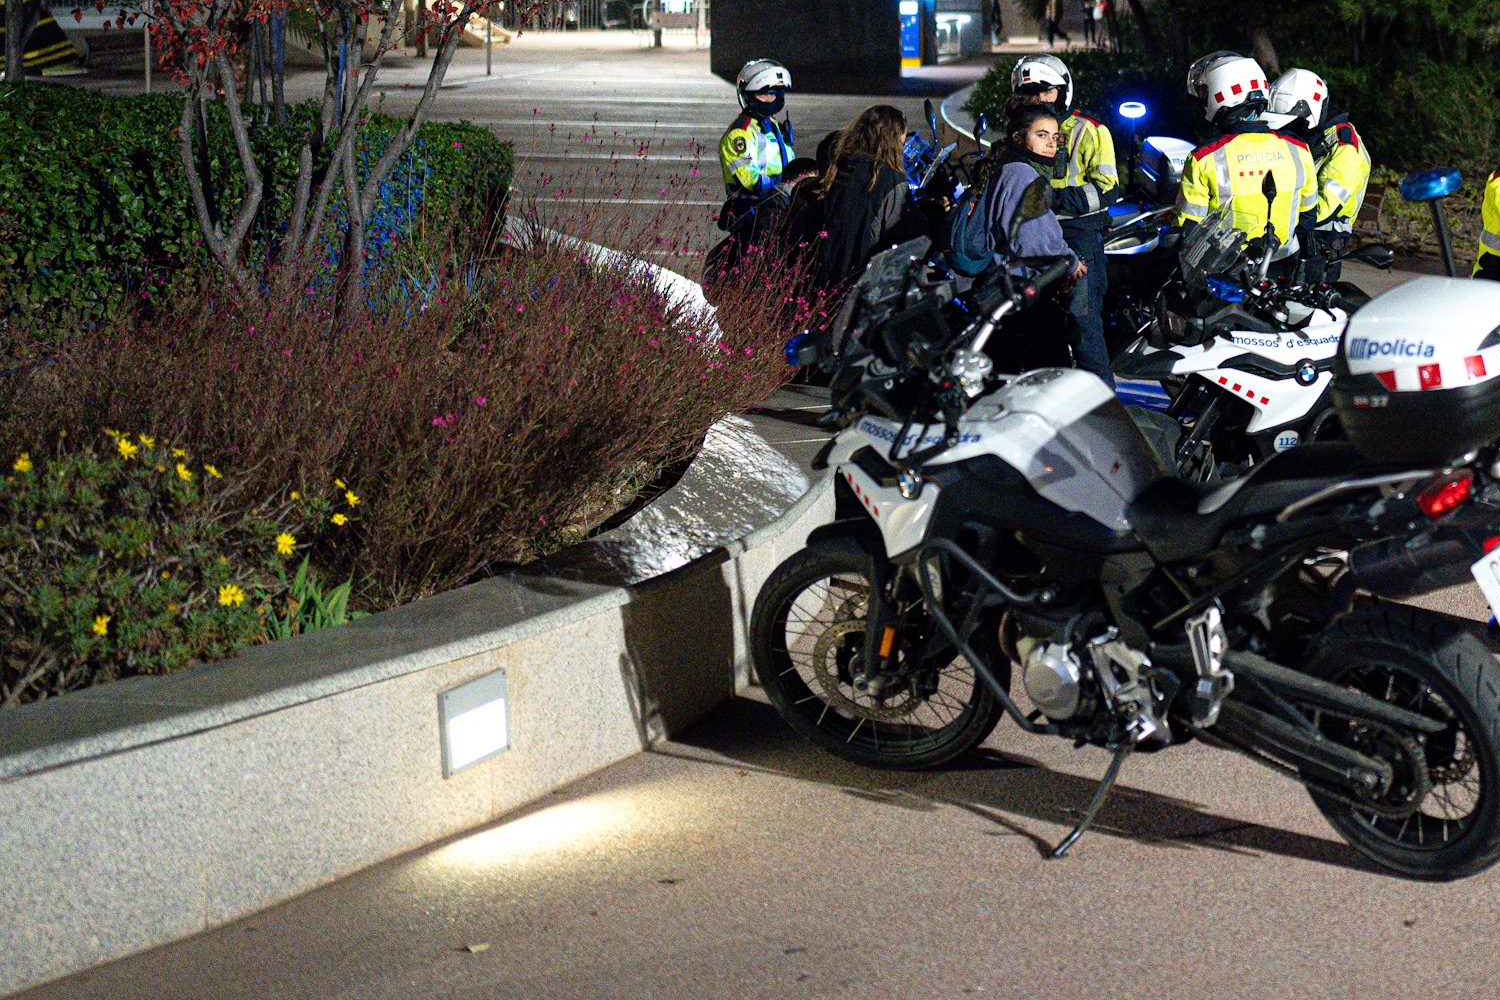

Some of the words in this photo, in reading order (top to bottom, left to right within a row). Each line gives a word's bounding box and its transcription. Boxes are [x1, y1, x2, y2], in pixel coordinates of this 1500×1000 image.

[1236, 151, 1285, 164] POLICIA
[1231, 336, 1279, 348] mossos
[1286, 334, 1340, 348] d'esquadr
[1367, 338, 1435, 359] policia
[1278, 437, 1297, 446] 112
